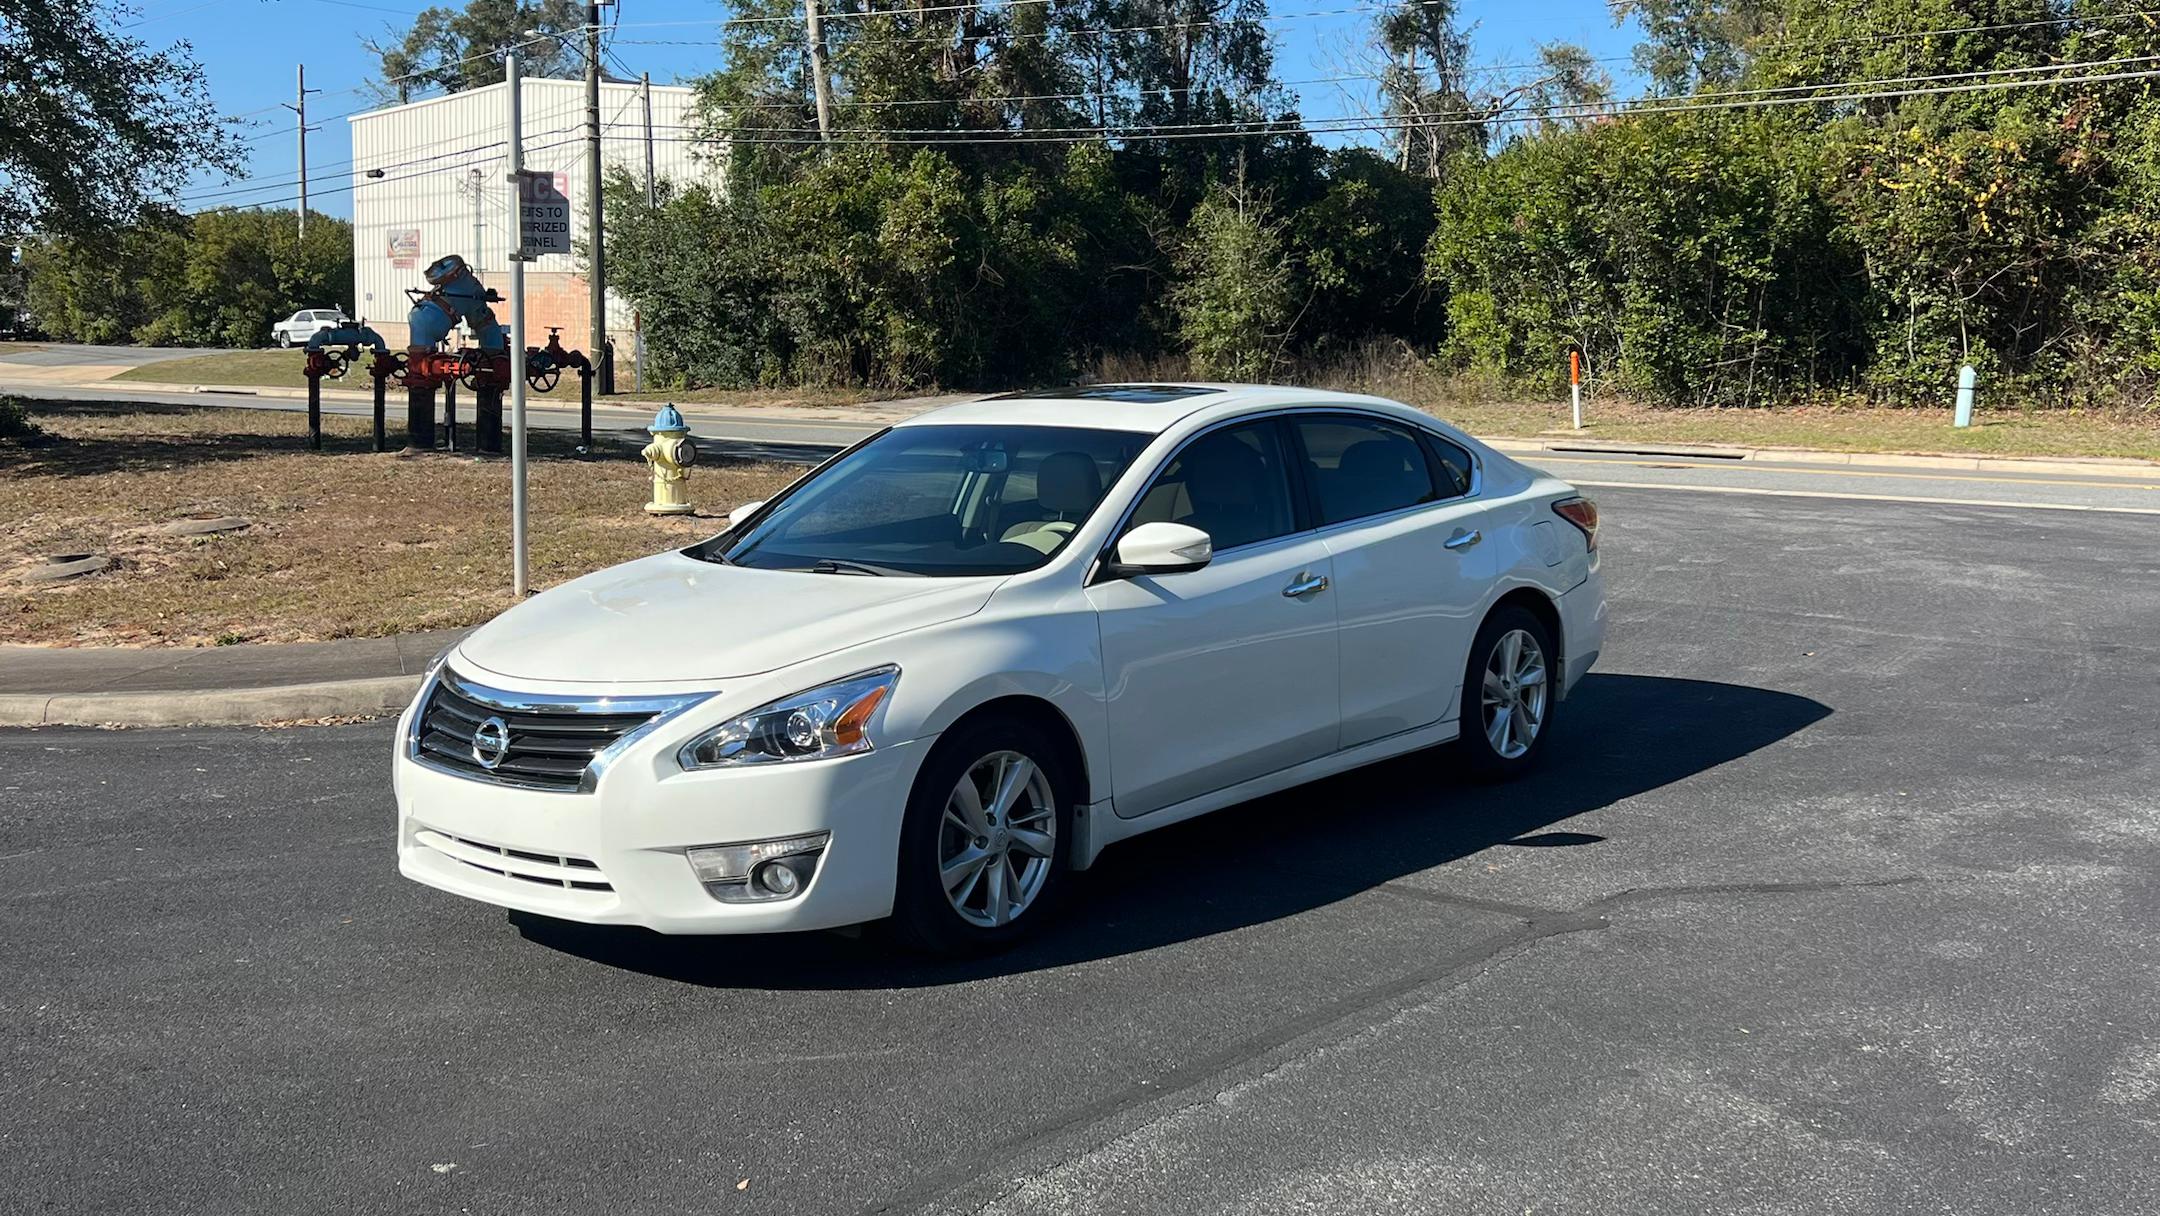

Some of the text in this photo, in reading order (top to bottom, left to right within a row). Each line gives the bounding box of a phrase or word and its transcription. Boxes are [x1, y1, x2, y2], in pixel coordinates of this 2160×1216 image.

[546, 207, 562, 218] TO
[531, 222, 567, 232] RIZED
[531, 237, 557, 248] NEL
